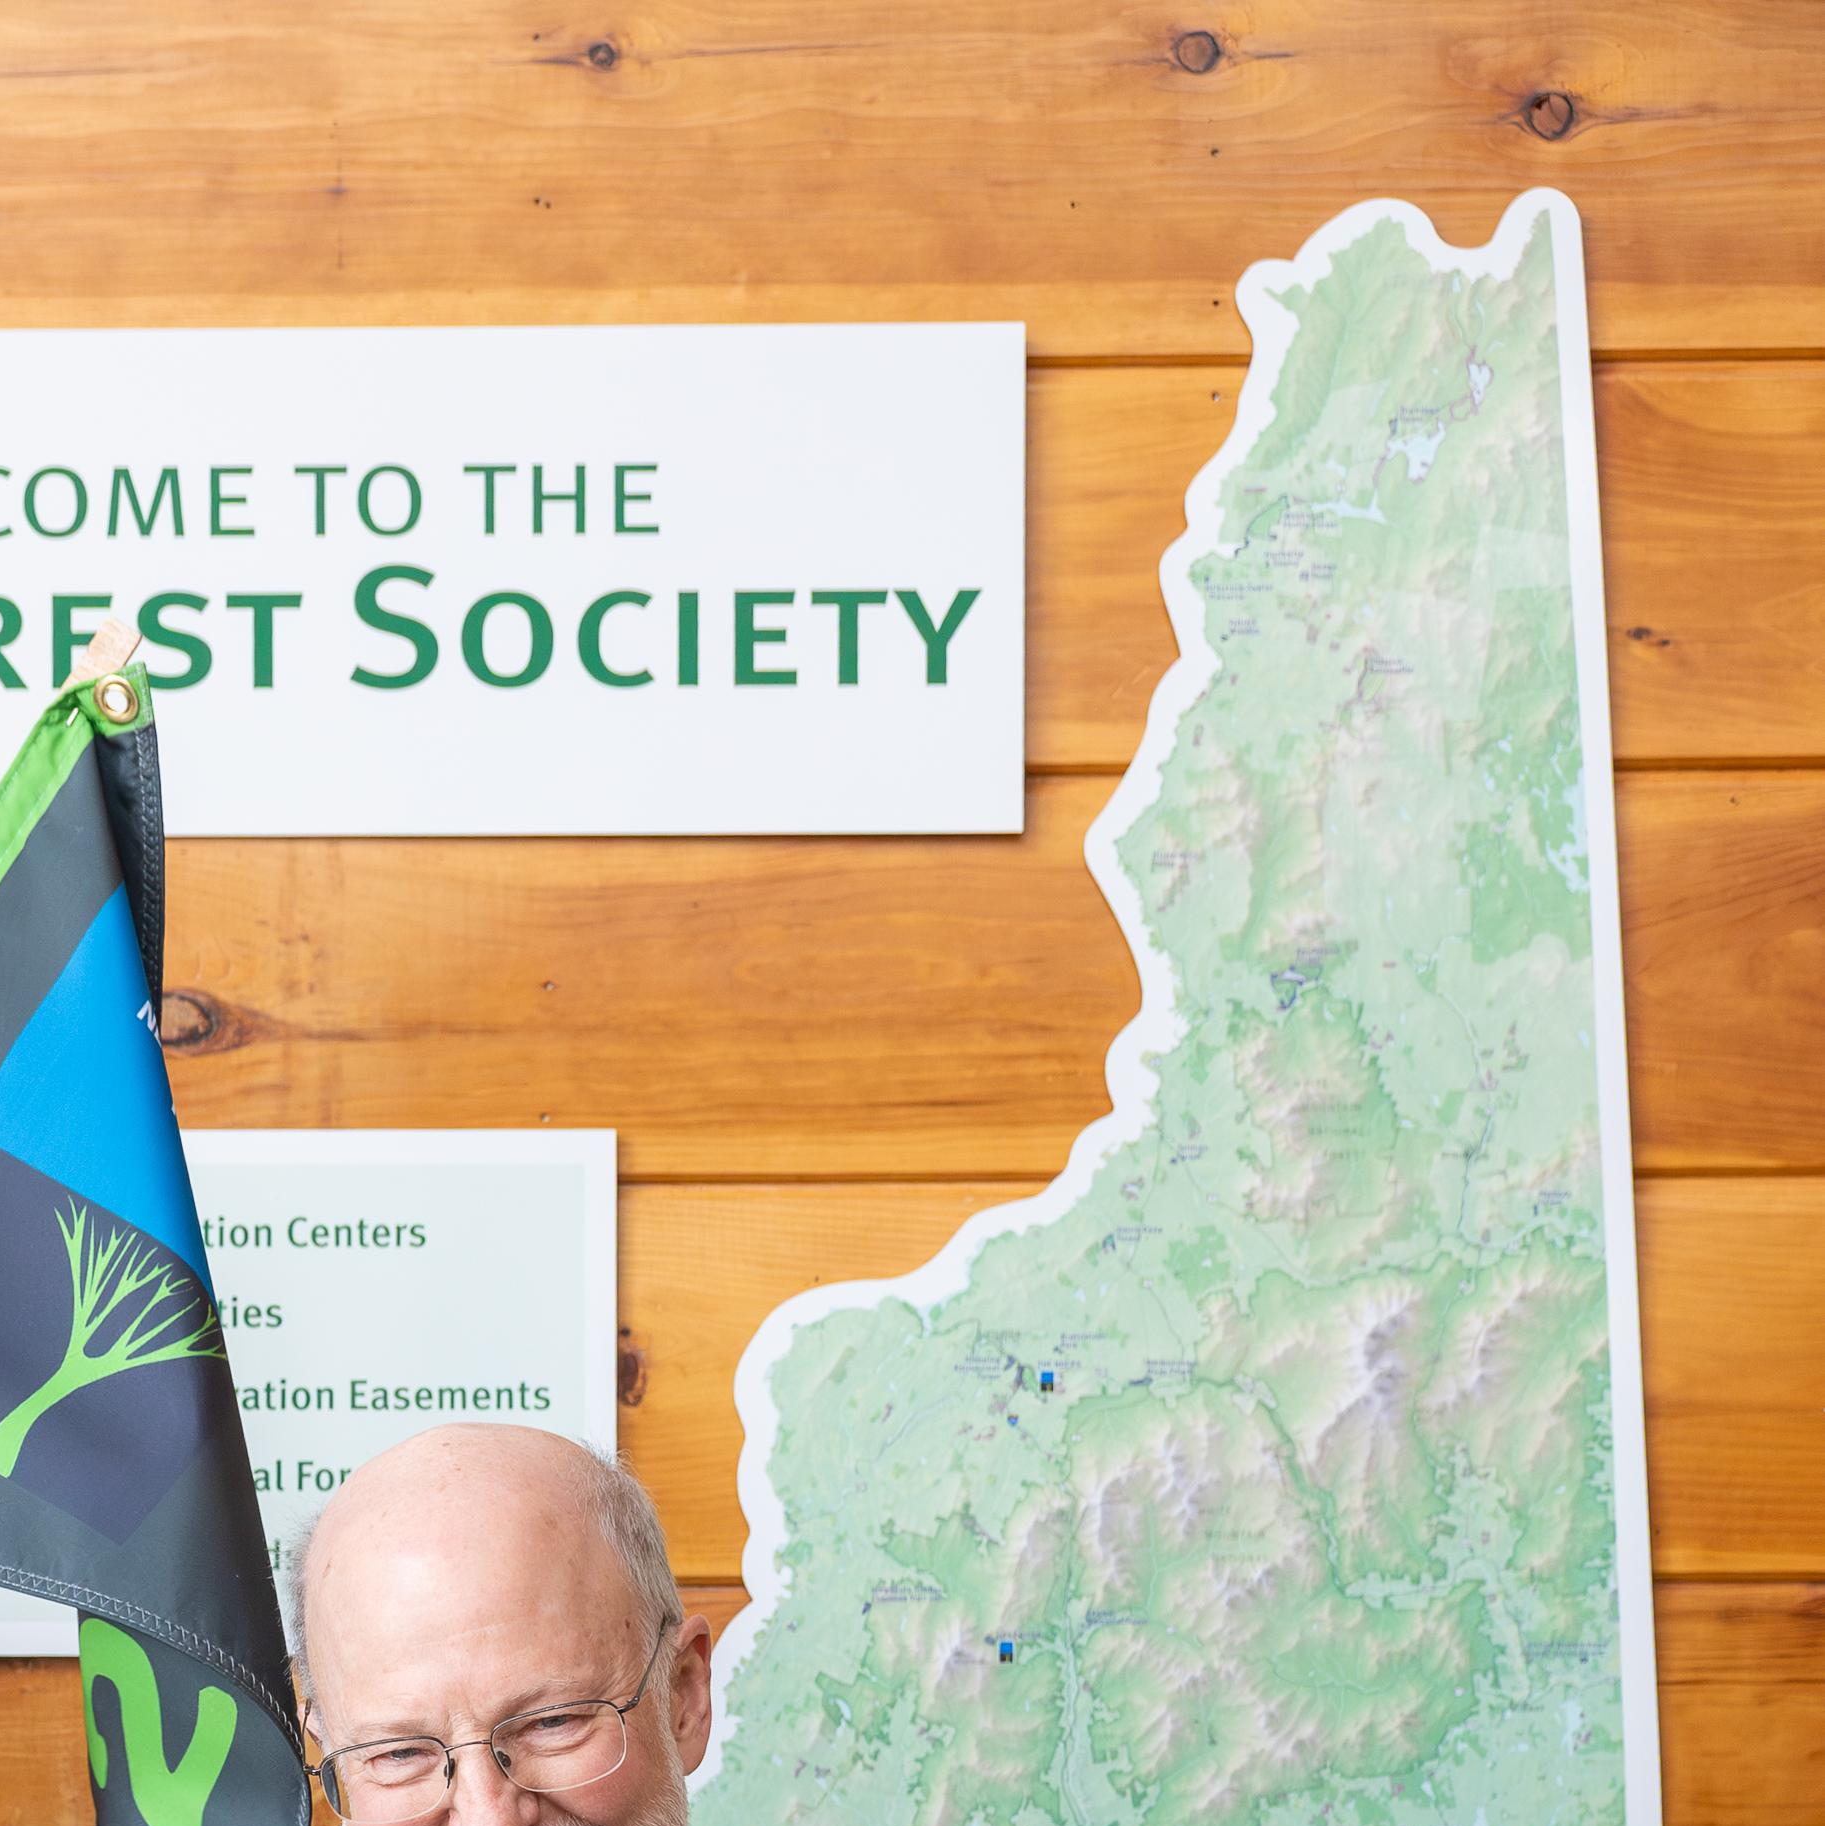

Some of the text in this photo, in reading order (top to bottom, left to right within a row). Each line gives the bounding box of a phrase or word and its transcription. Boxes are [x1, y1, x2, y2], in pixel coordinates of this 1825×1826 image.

[294, 464, 423, 538] TO
[463, 463, 661, 535] THE
[349, 562, 983, 690] SOCIETY
[202, 1216, 428, 1249] tion Centers
[349, 1379, 552, 1411] Easements
[296, 1461, 352, 1492] For
